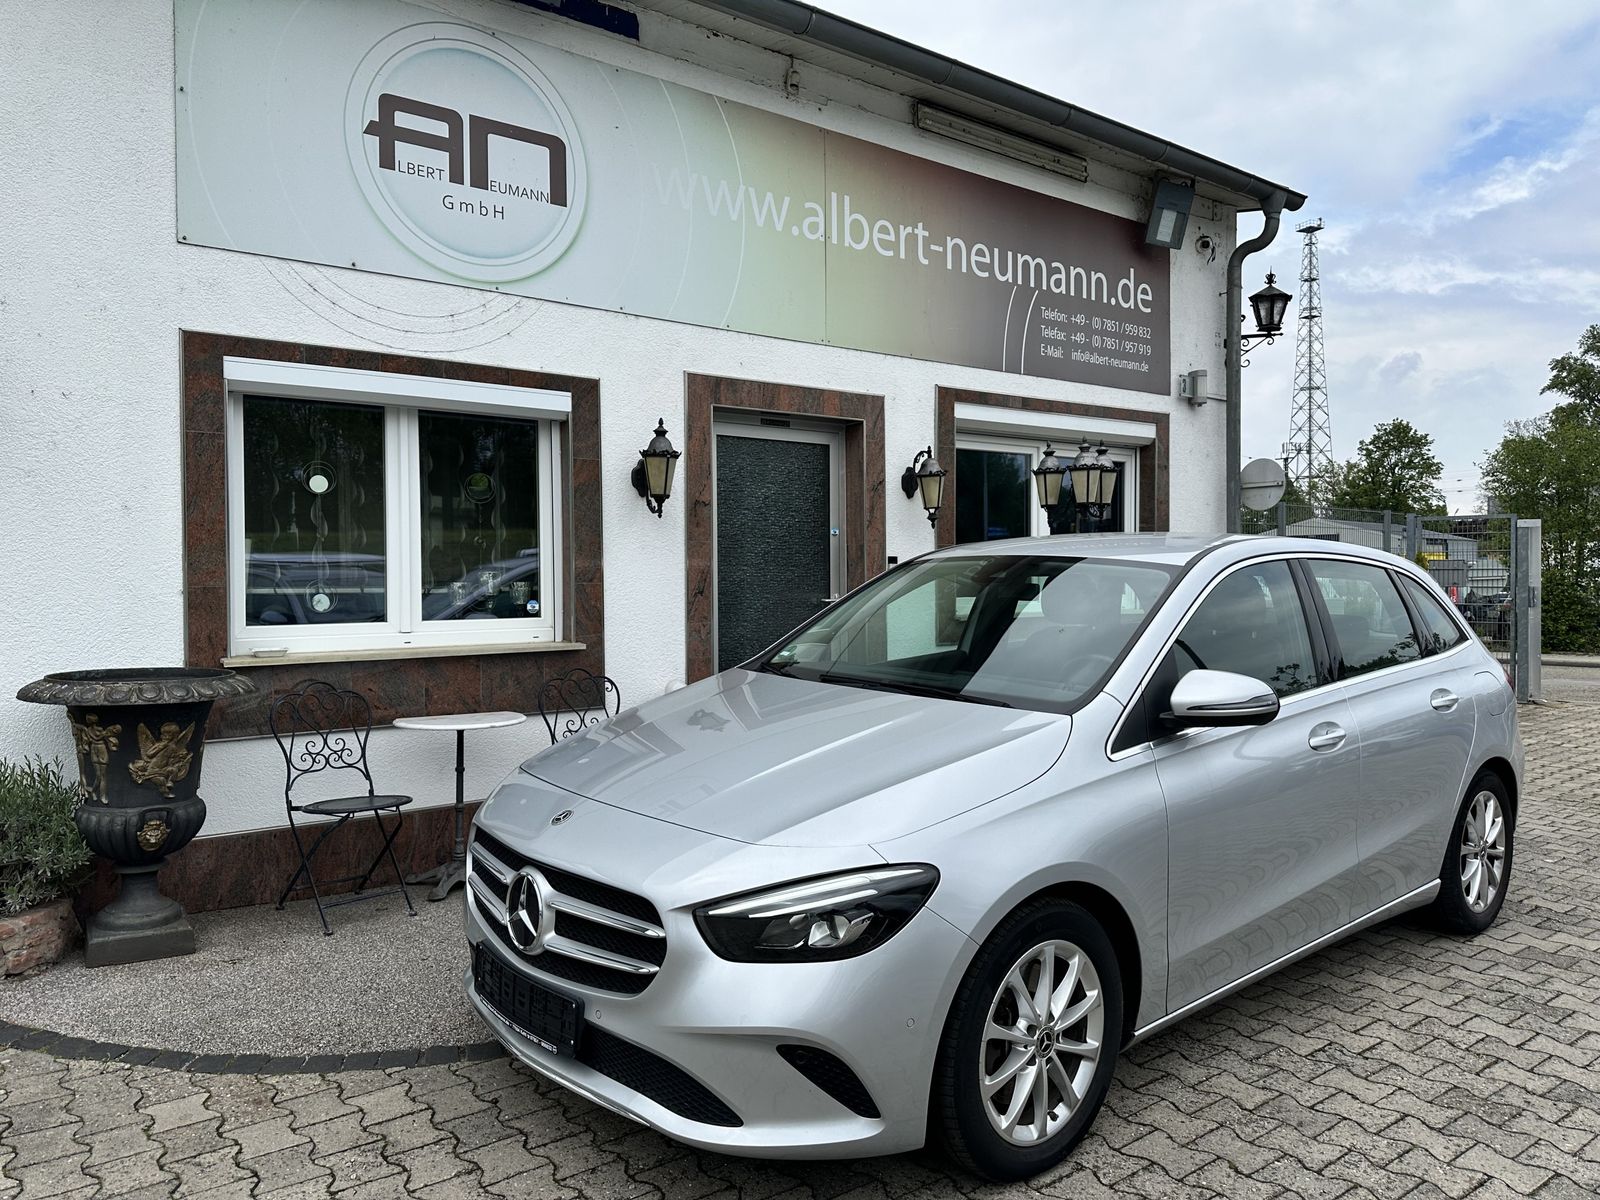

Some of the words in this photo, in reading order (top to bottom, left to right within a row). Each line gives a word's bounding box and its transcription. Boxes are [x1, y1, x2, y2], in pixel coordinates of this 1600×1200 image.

[442, 194, 505, 220] GmbH
[651, 162, 1153, 313] www.albert-neumann.de
[1040, 306, 1068, 323] Telefon:
[1092, 316, 1101, 331] (0)
[1103, 319, 1119, 332] 7851
[1040, 325, 1067, 341] Telefax:
[1092, 335, 1101, 349] (0)
[1103, 337, 1119, 350] 7851
[1040, 343, 1064, 358] E-Mail:
[1071, 348, 1149, 372] info@albert-neumann.de
